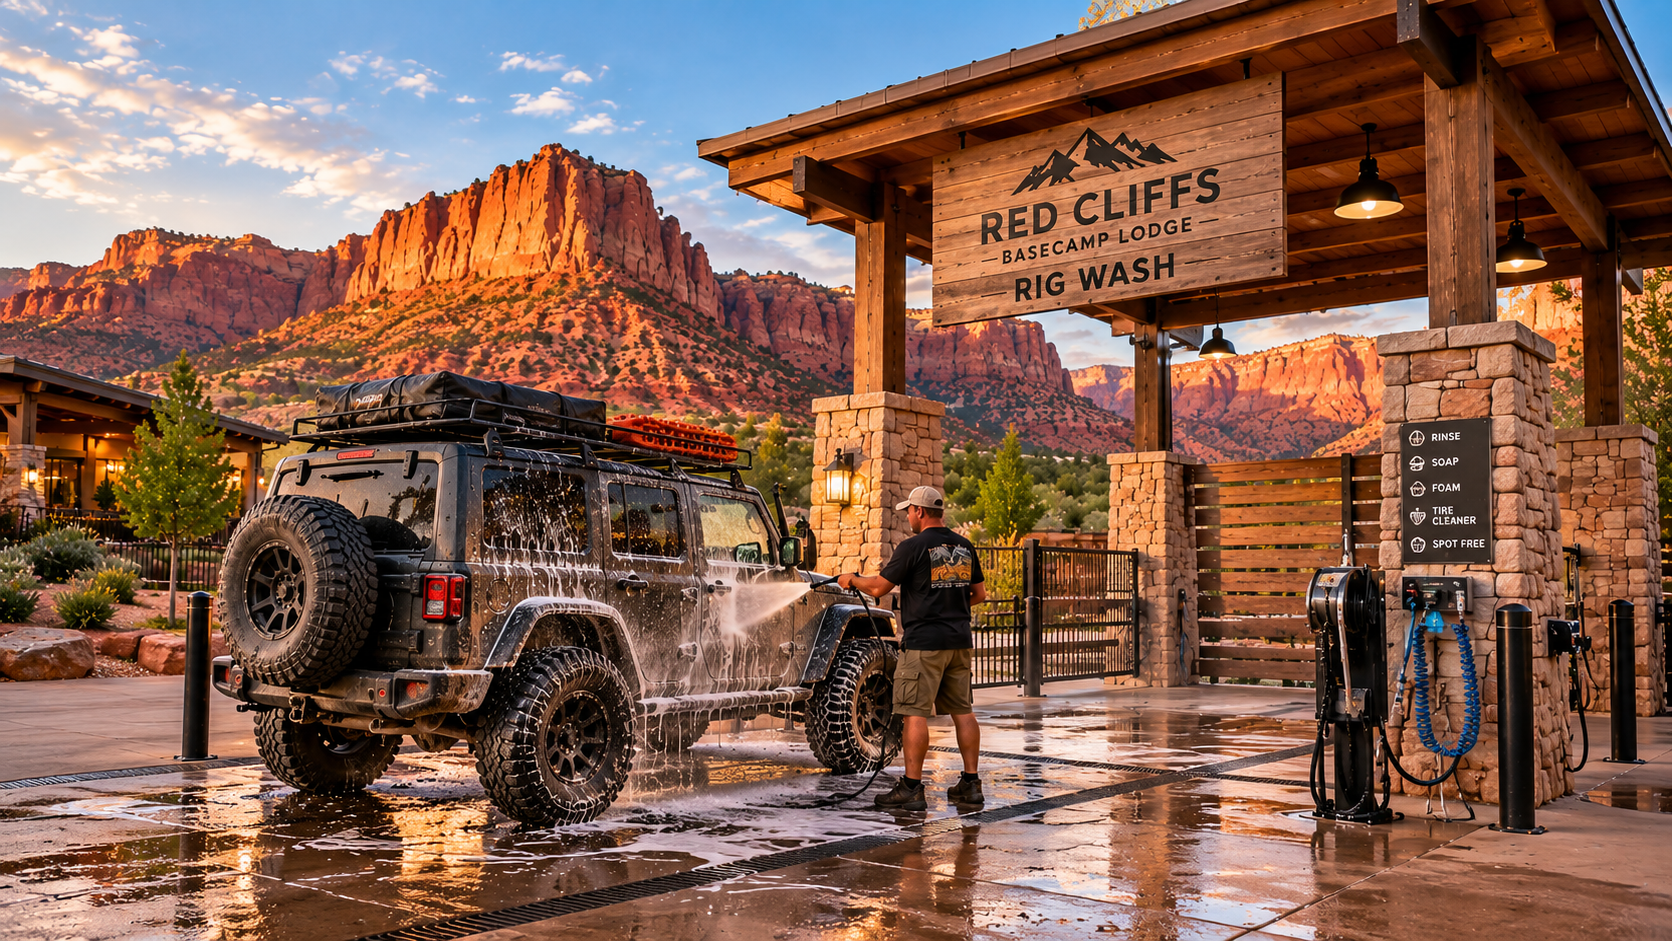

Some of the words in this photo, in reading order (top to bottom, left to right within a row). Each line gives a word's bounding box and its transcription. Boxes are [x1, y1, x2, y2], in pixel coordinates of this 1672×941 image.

[982, 202, 1058, 245] RED
[1073, 168, 1220, 225] CLIFFS
[1002, 231, 1109, 265] BASECAMP
[1118, 216, 1192, 243] LODGE
[1016, 272, 1064, 302] RIG
[1078, 253, 1175, 291] WASH
[1431, 431, 1461, 442] RINSE
[1431, 456, 1460, 467] SOAP
[1432, 482, 1461, 493] FOAM
[1432, 505, 1454, 516] TIRE
[1432, 516, 1477, 526] CLEANER
[1432, 539, 1459, 549] SPOT
[1461, 538, 1486, 549] FREE
